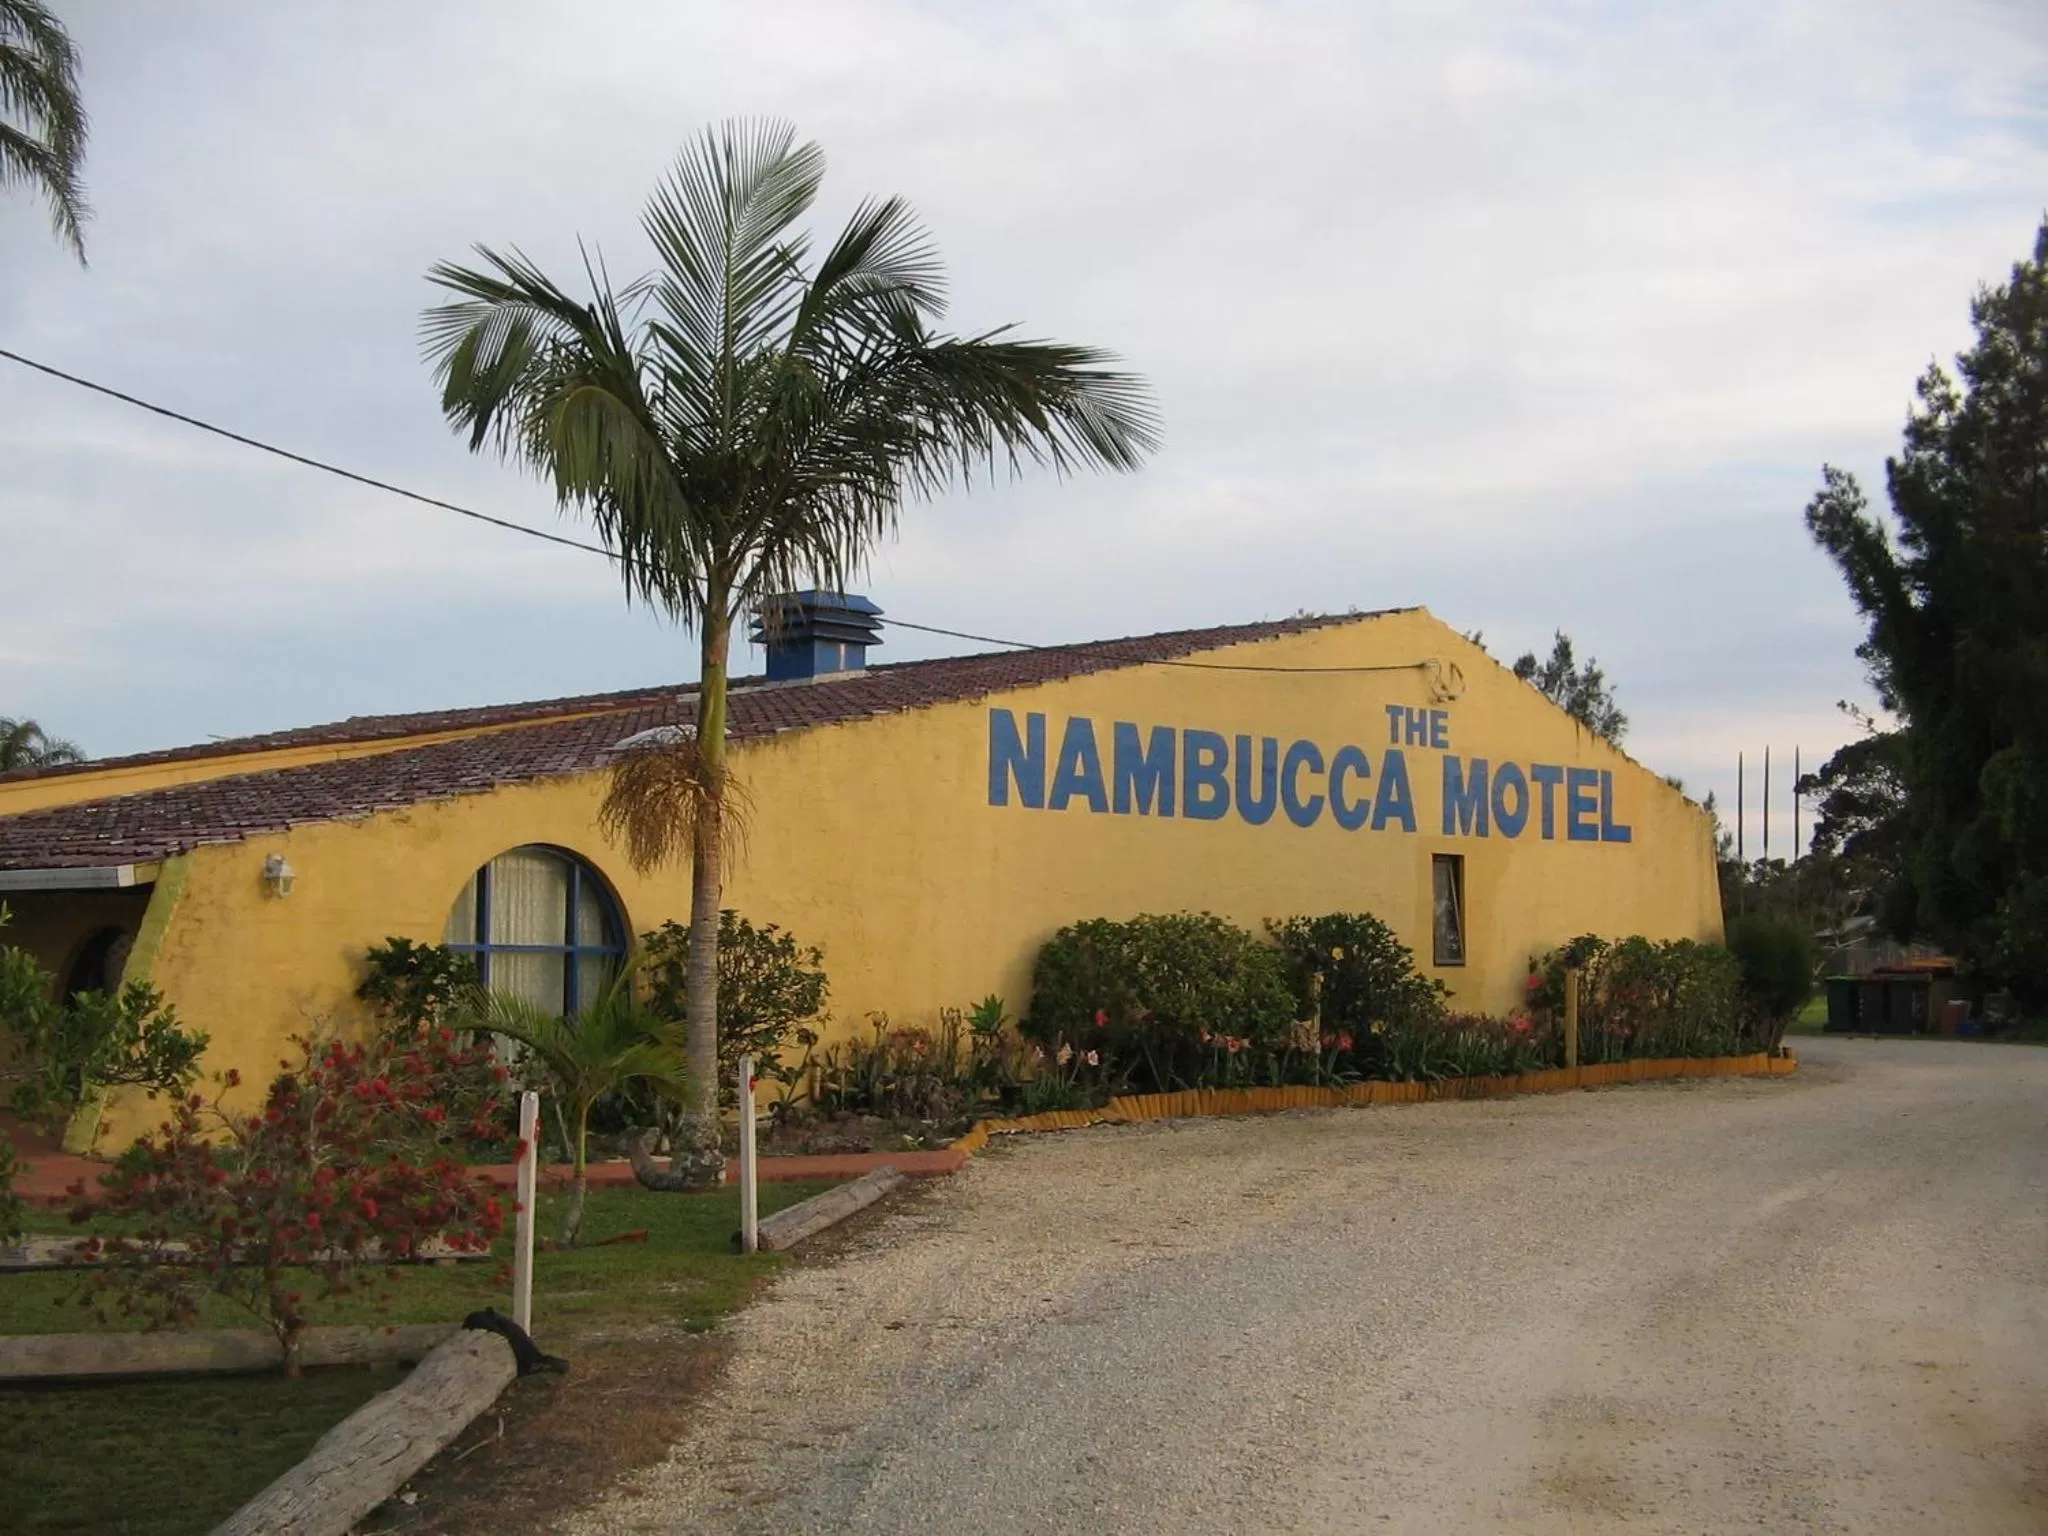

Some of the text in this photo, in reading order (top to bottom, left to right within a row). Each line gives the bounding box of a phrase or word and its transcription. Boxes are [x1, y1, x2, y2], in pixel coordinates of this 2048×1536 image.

[1386, 704, 1449, 749] THE
[988, 708, 1632, 843] NAMBUCCA MOTEL
